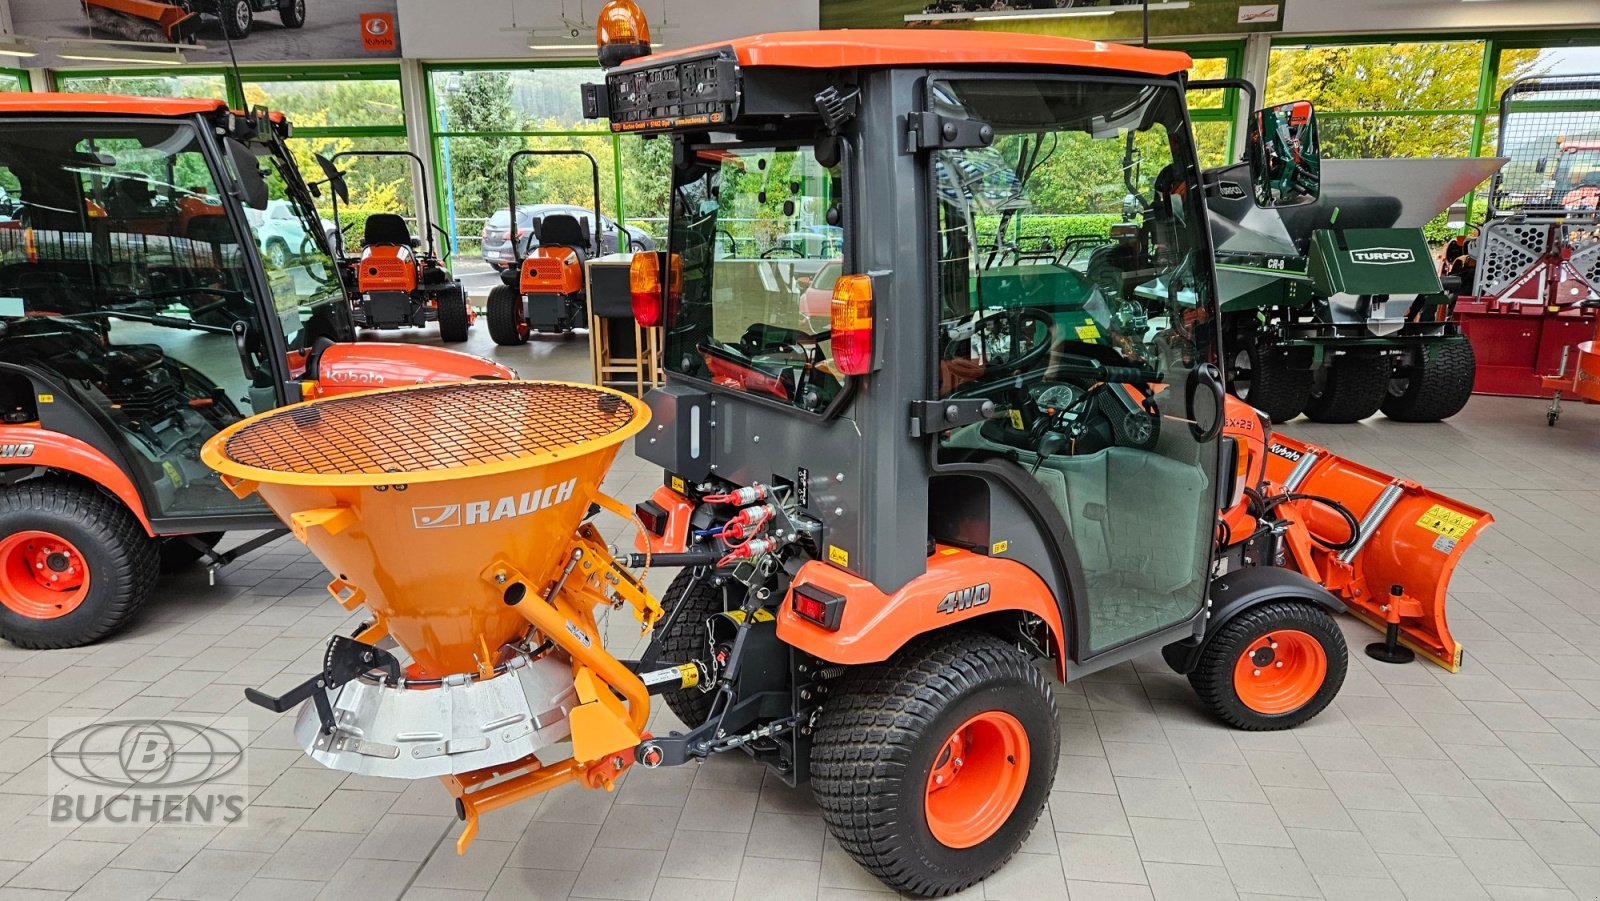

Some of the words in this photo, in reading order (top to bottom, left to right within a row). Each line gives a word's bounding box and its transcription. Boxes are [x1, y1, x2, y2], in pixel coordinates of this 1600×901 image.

[1267, 258, 1285, 270] CR-8
[1355, 252, 1409, 261] TURFCO
[326, 370, 384, 384] Kubota
[0, 442, 35, 459] WD
[1270, 443, 1300, 462] Kubota
[465, 477, 577, 525] RAUCH
[936, 582, 991, 615] 4WD
